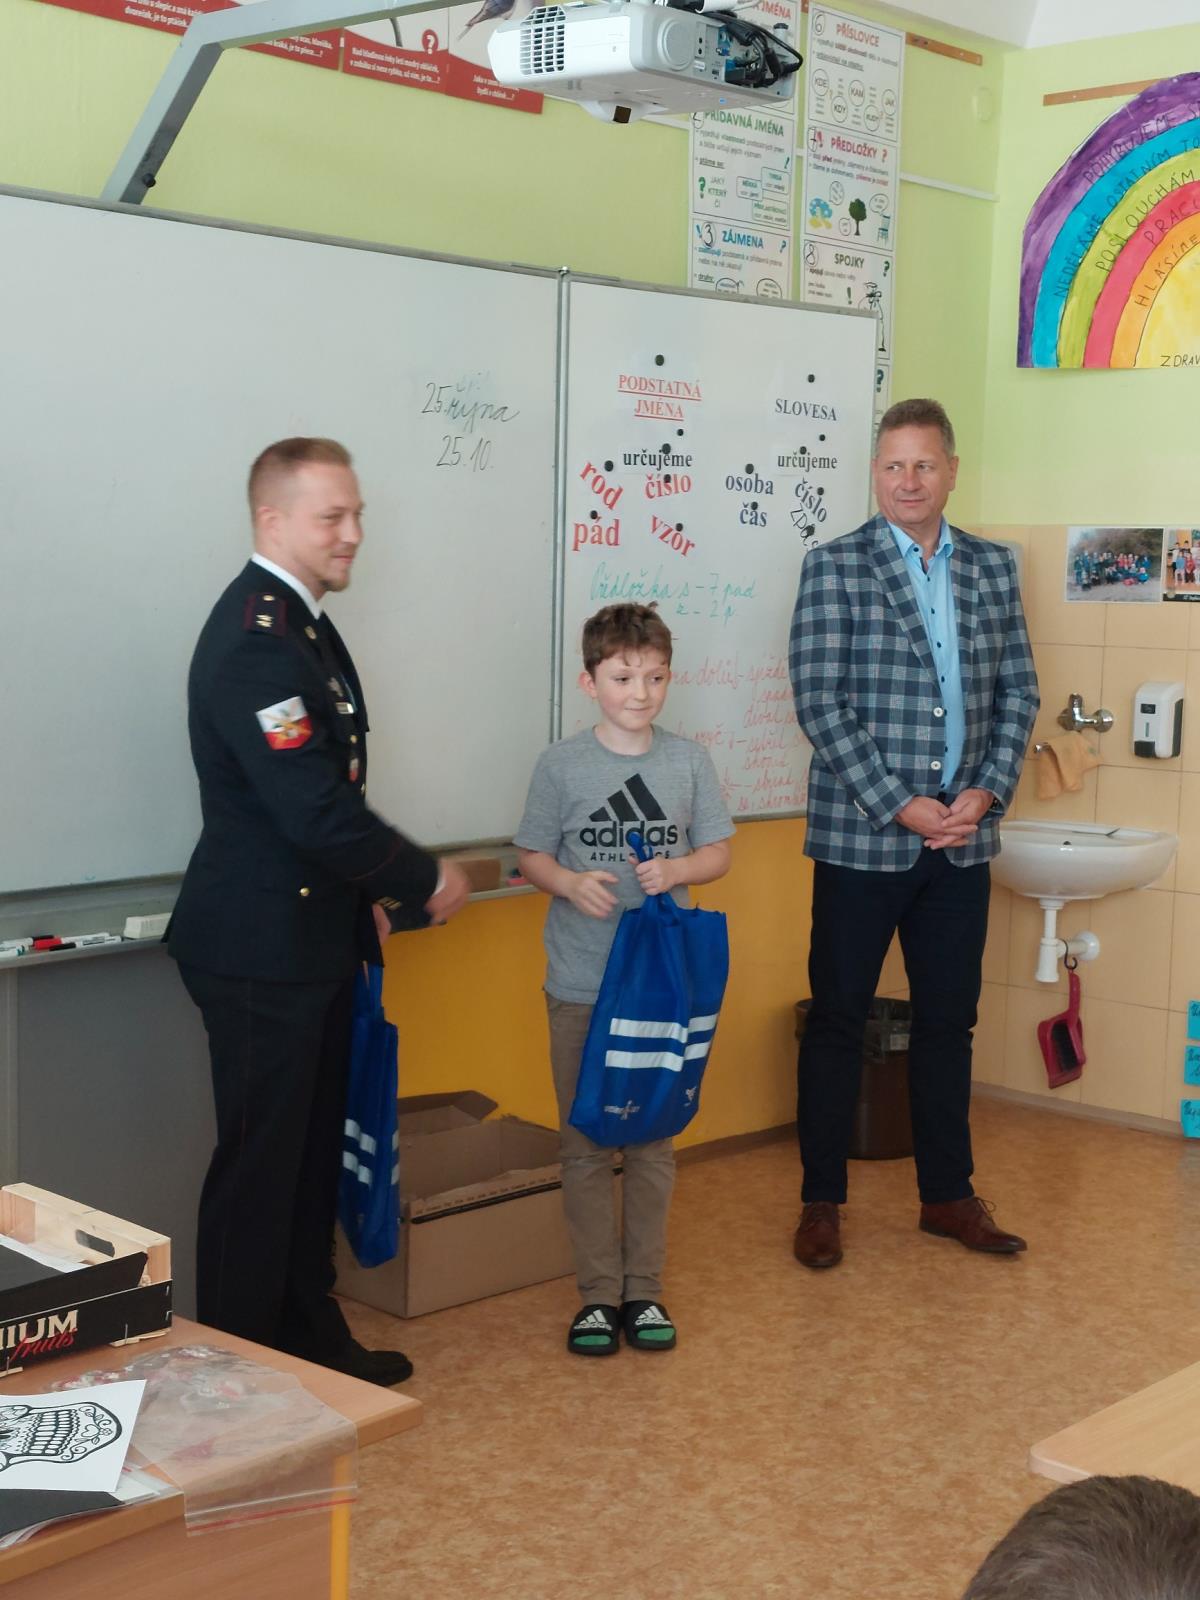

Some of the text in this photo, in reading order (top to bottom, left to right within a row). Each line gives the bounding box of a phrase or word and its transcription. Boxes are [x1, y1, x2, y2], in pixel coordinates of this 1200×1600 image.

[722, 228, 764, 249] ZÁJMENA
[834, 253, 865, 269] SPOJKY
[618, 374, 702, 399] PODSTATNÁ
[634, 398, 684, 419] JMÉNA
[775, 398, 838, 422] SLOVESA
[622, 449, 693, 471] určujeme
[777, 450, 838, 473] určujeme
[579, 461, 624, 510] rod
[644, 473, 692, 499] číslo
[725, 474, 774, 496] osoba
[795, 476, 827, 523] číslo
[739, 502, 768, 527] čas
[572, 515, 621, 552] pád
[650, 515, 696, 557] vzor
[580, 820, 678, 848] adidas
